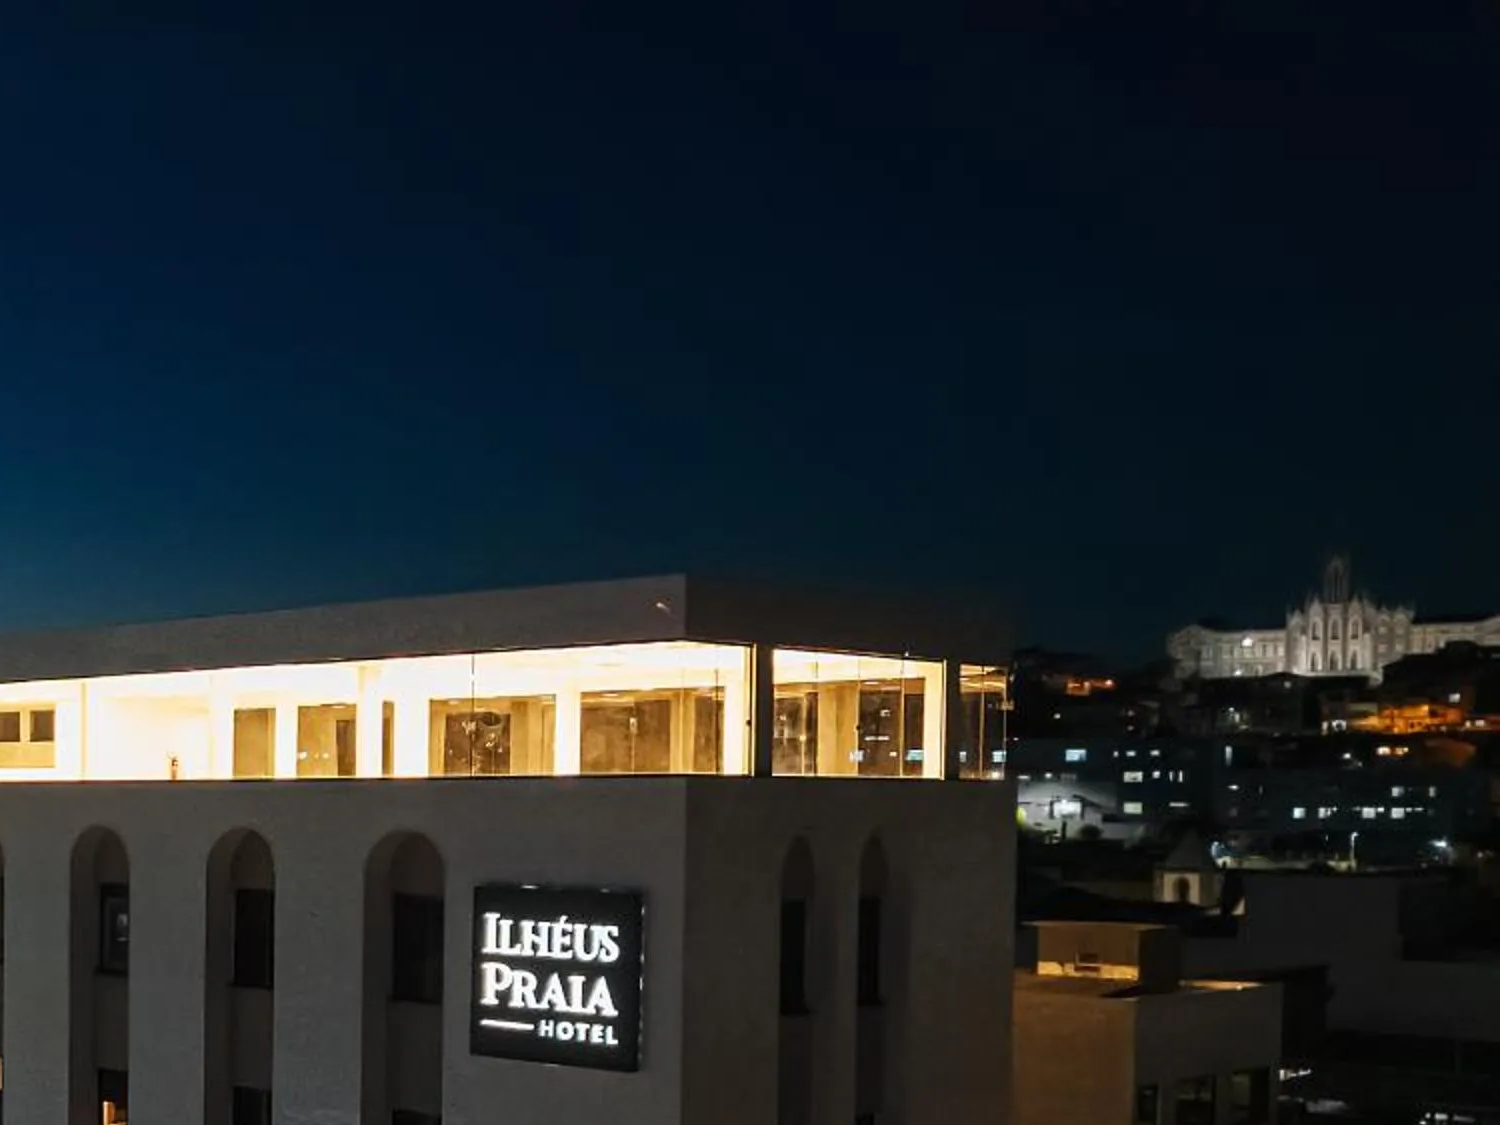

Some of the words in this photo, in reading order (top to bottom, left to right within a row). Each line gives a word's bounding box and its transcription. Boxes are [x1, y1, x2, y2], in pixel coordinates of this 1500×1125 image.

[481, 911, 621, 963] ILHÉUS
[480, 961, 619, 1017] PRAIA
[537, 1019, 619, 1045] HOTEL
